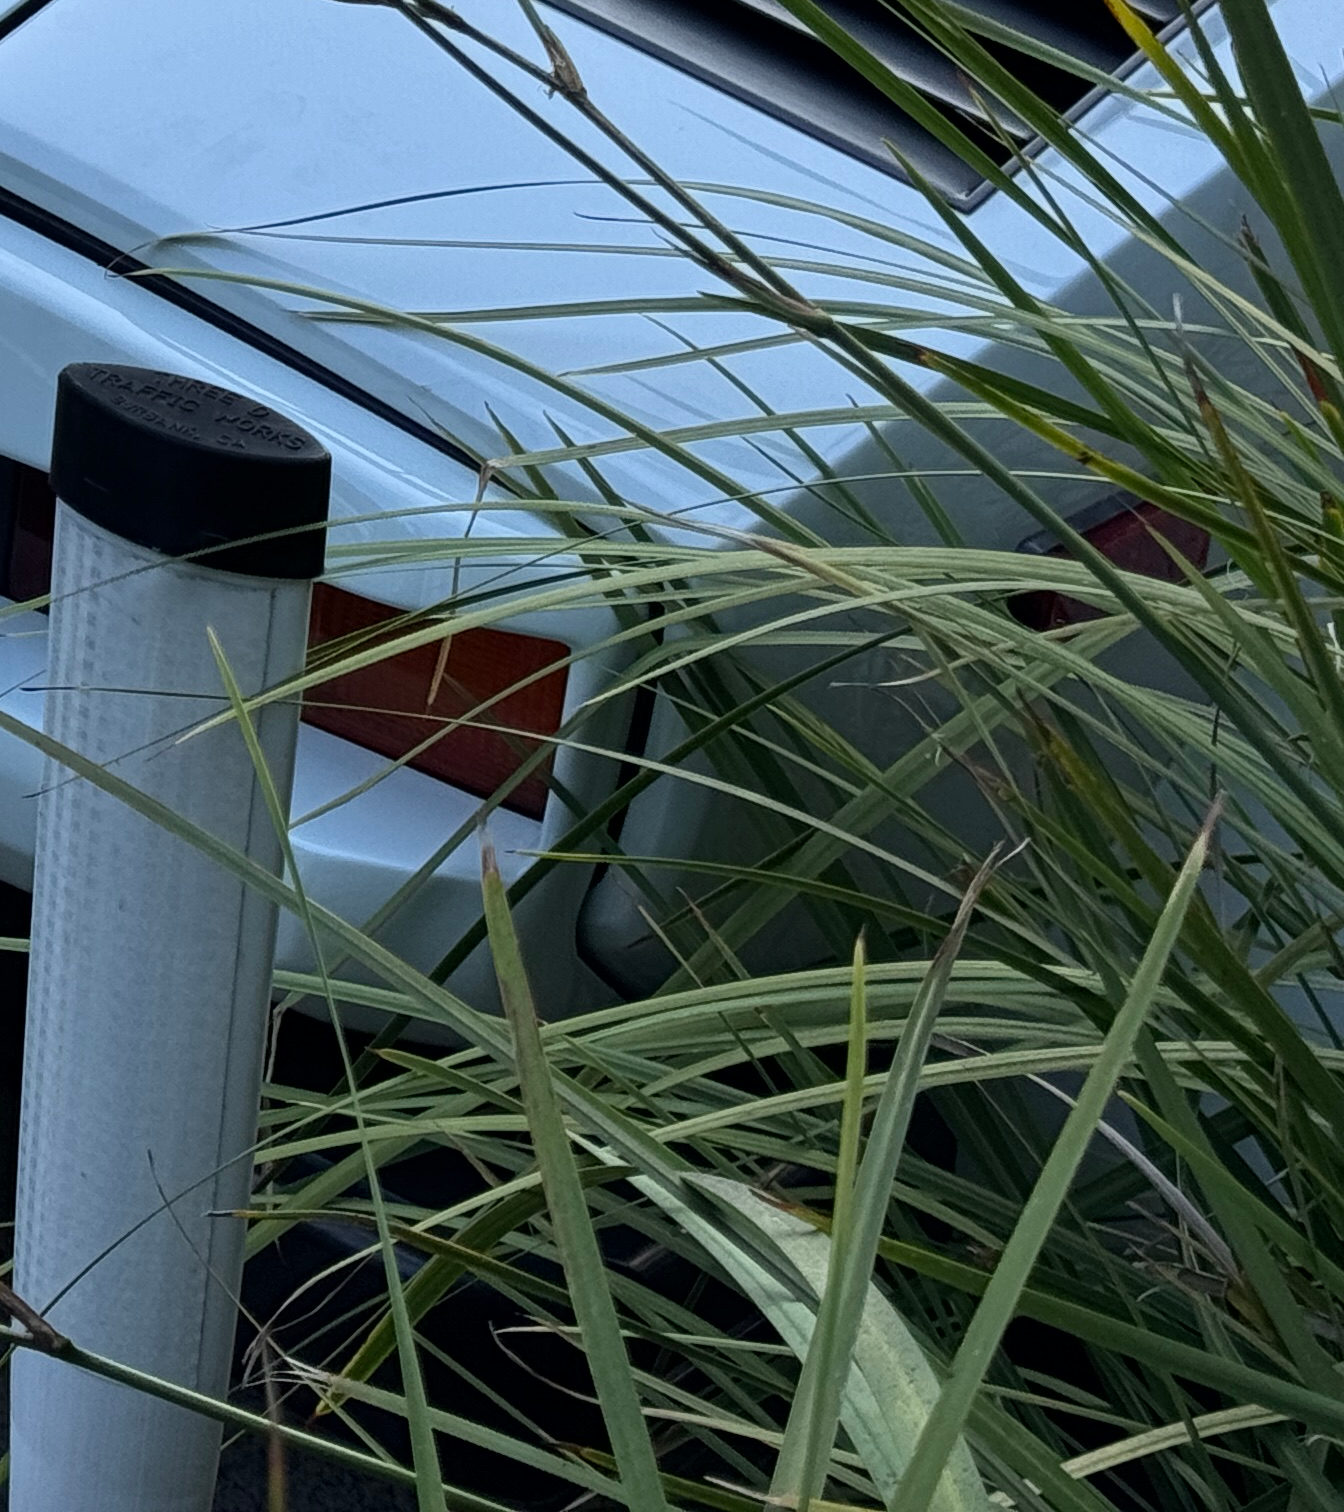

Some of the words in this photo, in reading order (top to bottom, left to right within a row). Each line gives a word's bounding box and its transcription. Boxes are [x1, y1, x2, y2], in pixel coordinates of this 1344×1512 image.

[89, 368, 200, 413] TRAFFIC
[215, 413, 307, 451] WORKS
[154, 371, 242, 407] THREE
[246, 405, 271, 419] D
